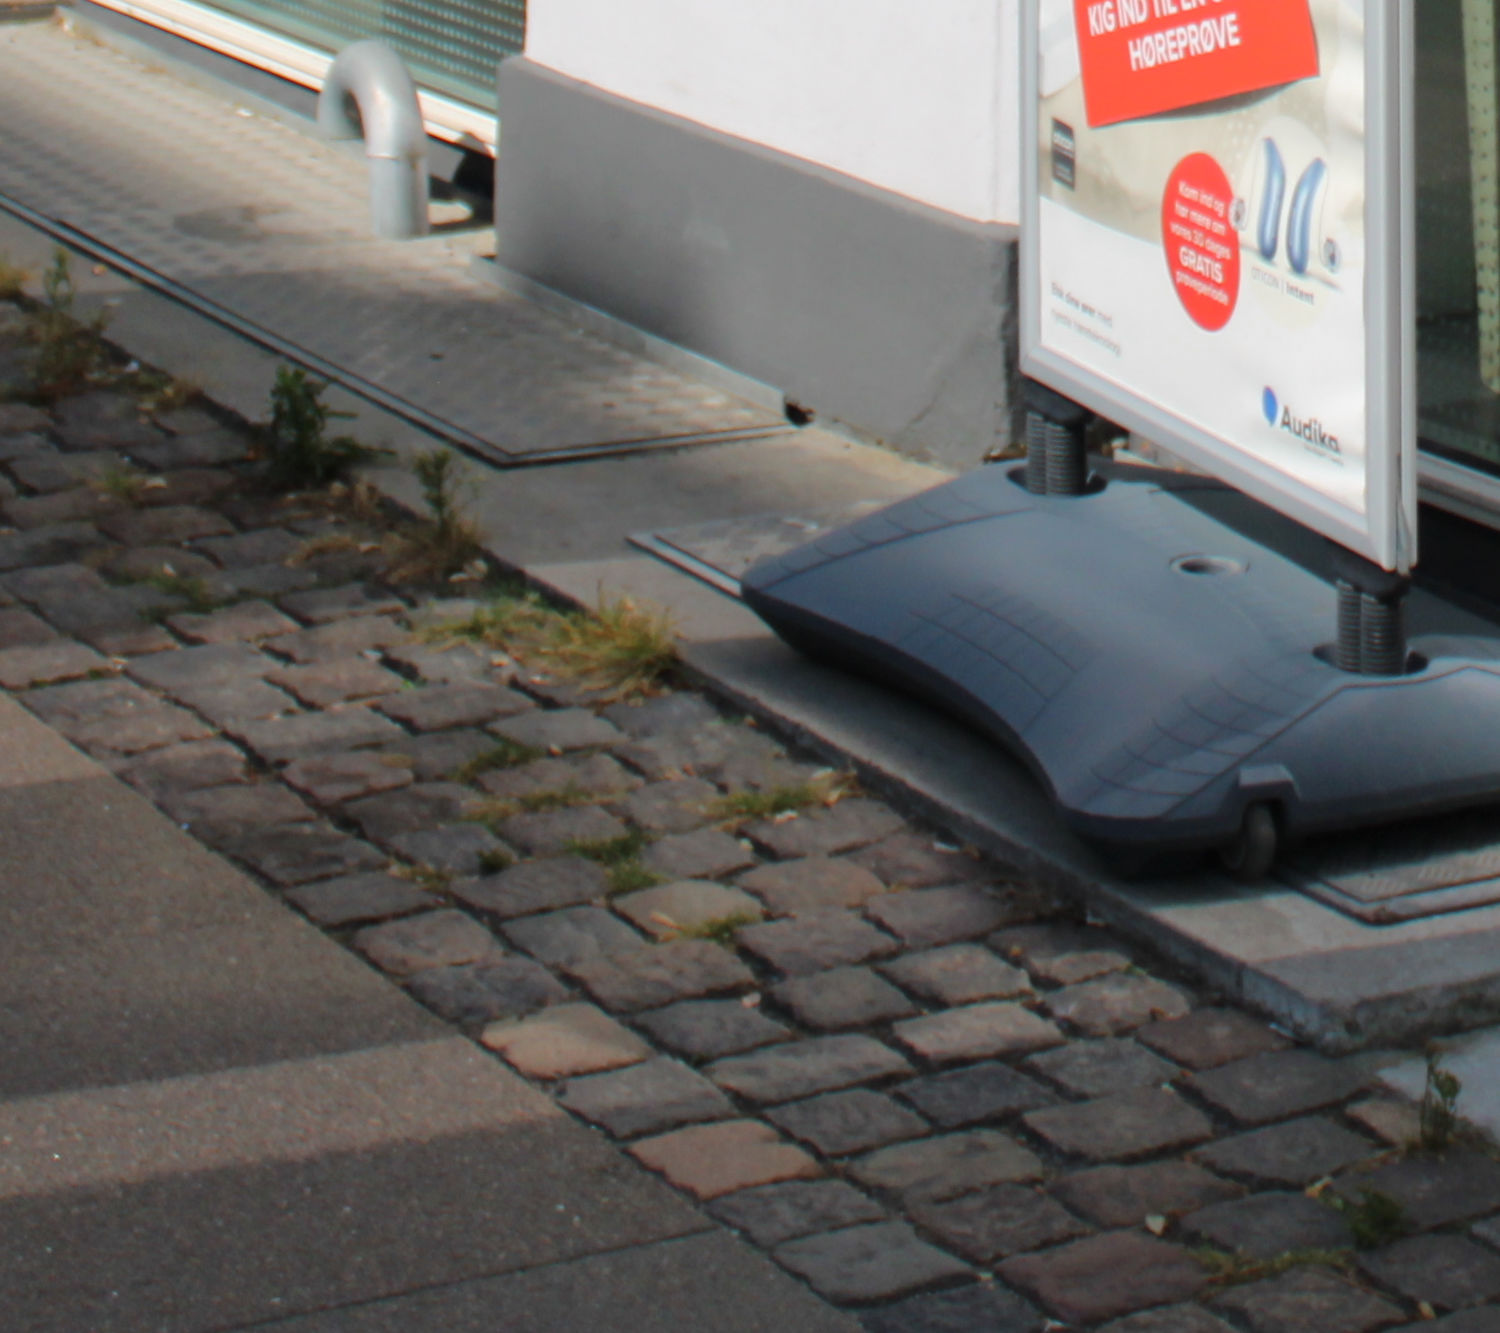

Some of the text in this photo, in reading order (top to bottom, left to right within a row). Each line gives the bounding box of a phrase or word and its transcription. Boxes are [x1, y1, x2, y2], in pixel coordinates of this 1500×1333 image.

[1088, 0, 1117, 37] KIG
[1128, 12, 1241, 72] HØREPRØVE
[1179, 245, 1224, 284] GRATIS
[1280, 404, 1341, 455] Audika
